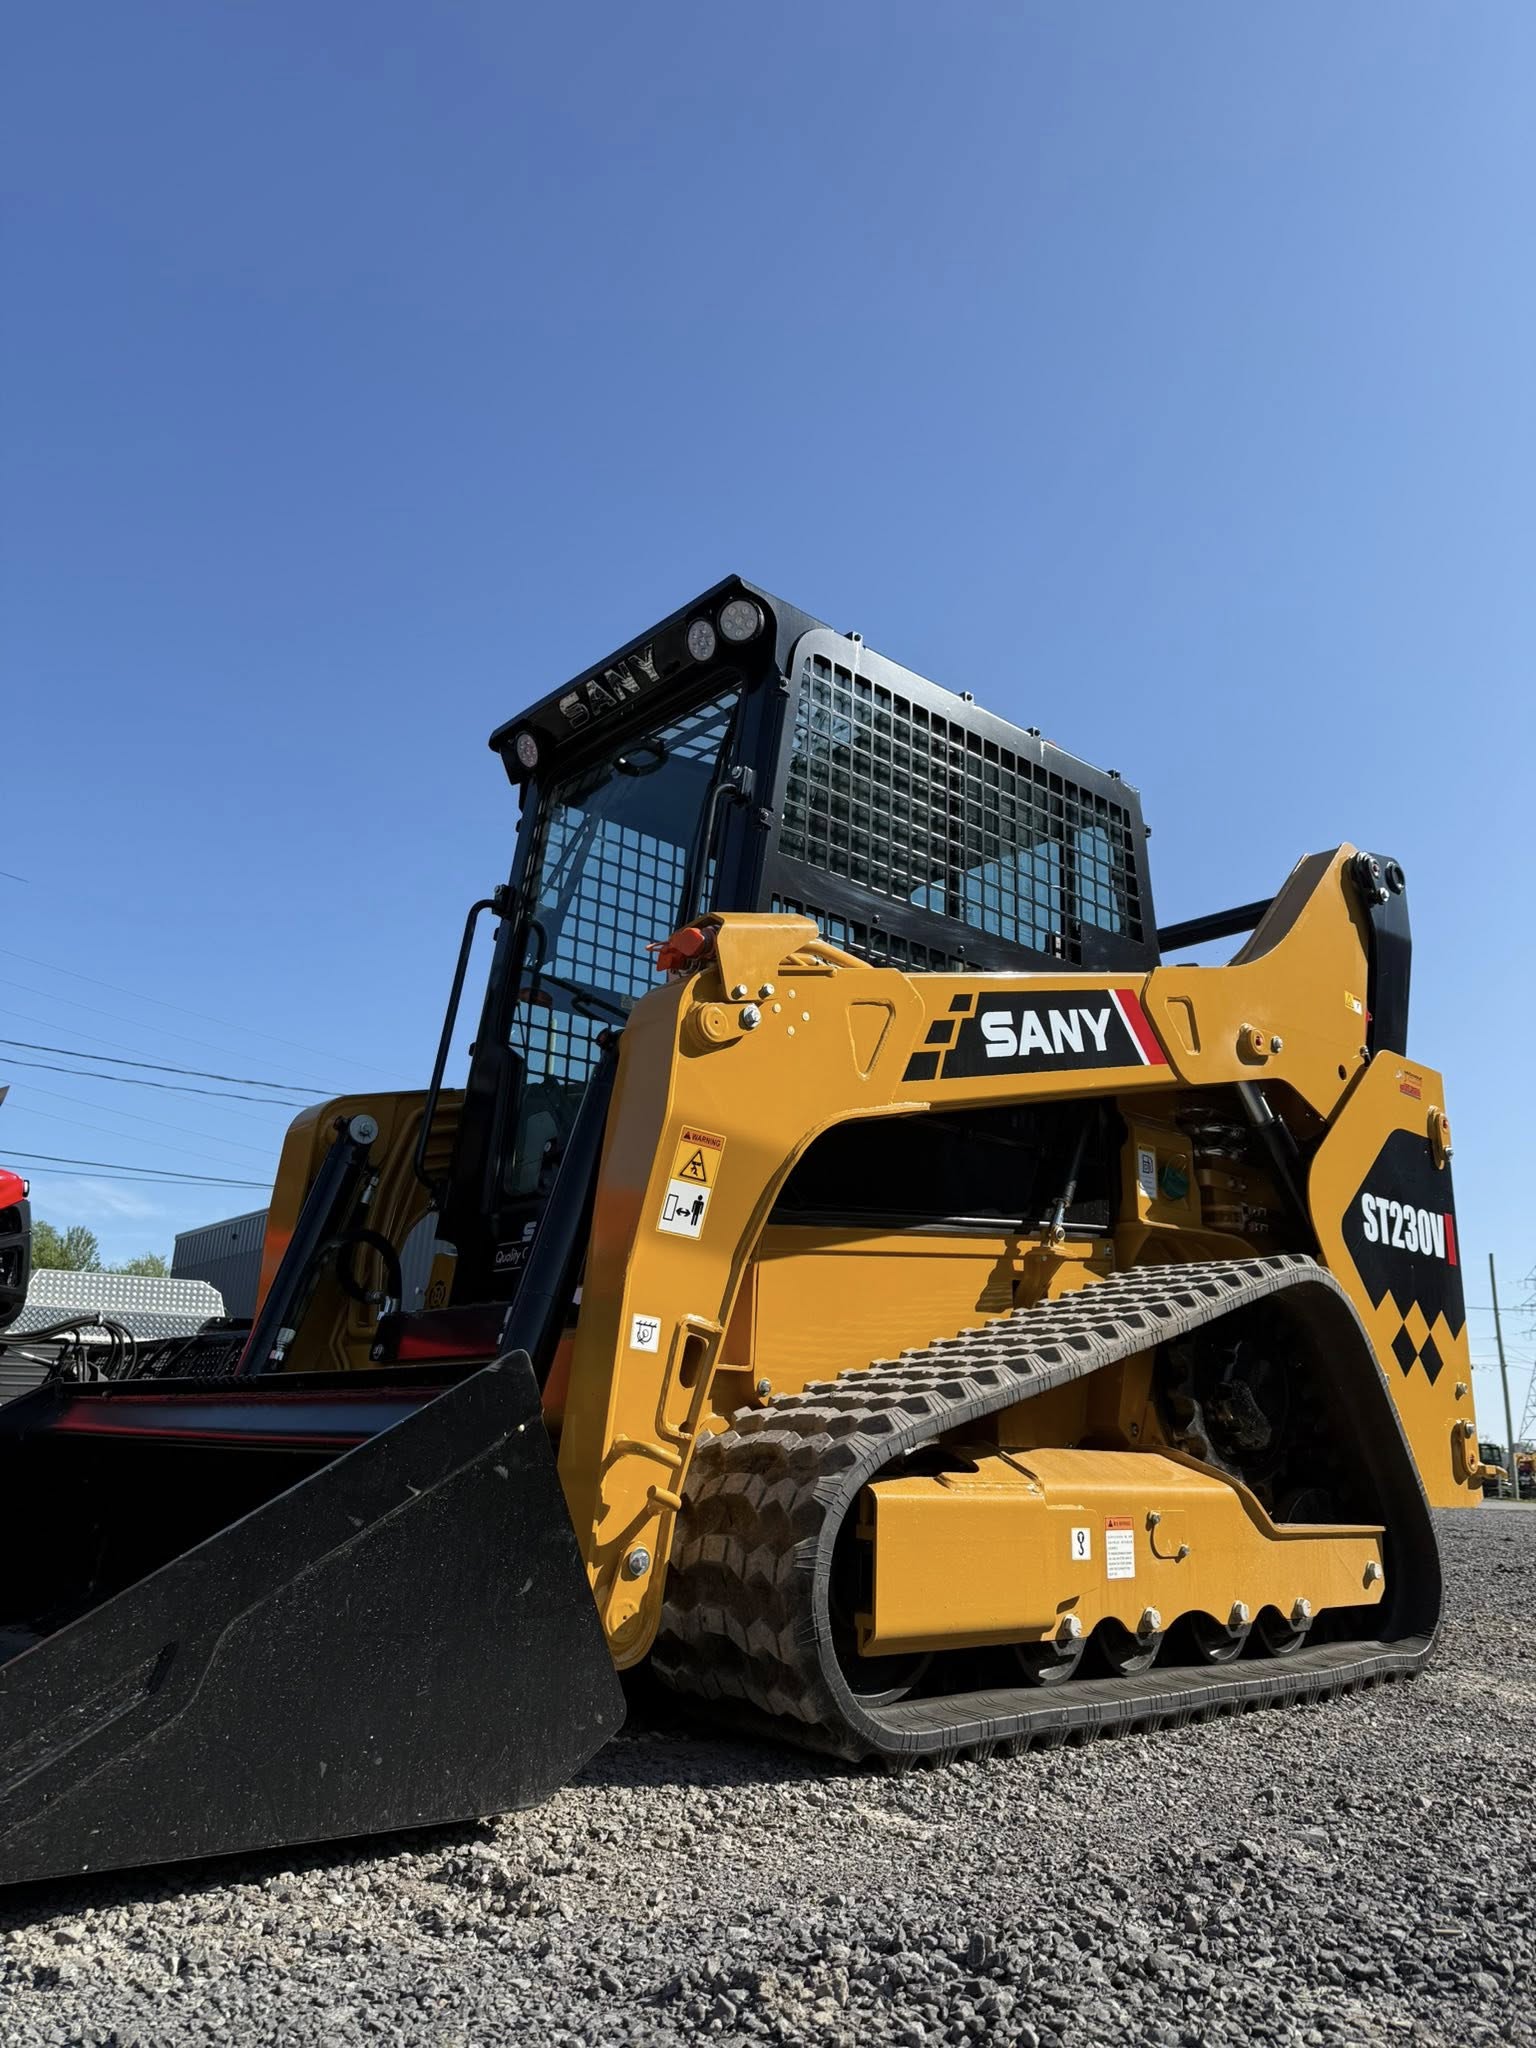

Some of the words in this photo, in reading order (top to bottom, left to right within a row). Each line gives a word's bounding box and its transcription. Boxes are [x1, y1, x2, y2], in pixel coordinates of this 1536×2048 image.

[559, 643, 660, 729] SANY
[980, 1008, 1111, 1058] SANY
[692, 1133, 721, 1147] WARNING
[1361, 1192, 1446, 1259] ST230V
